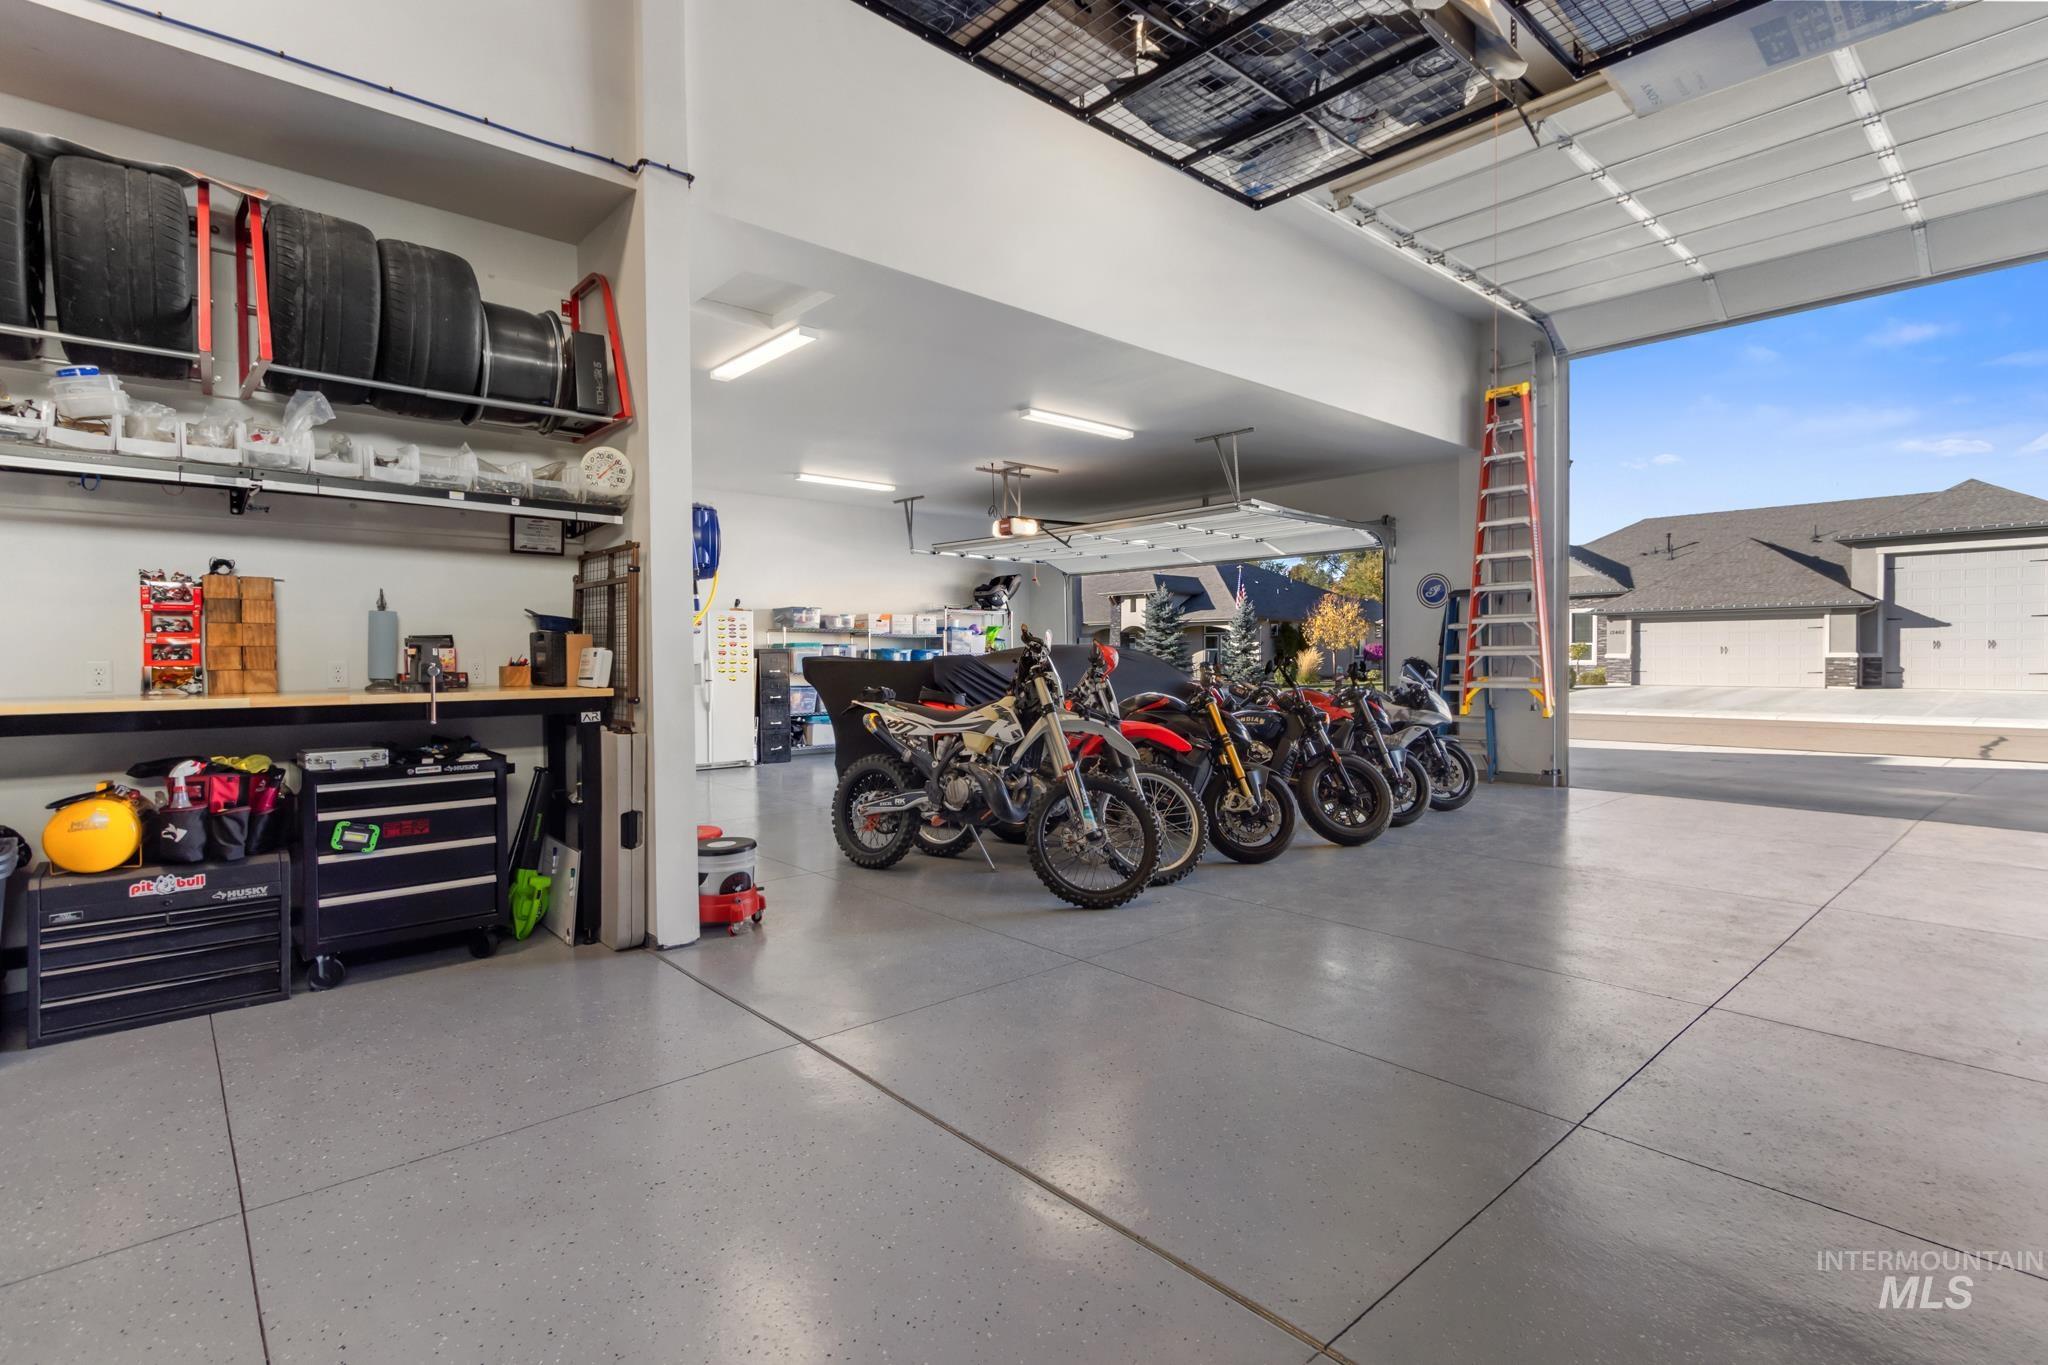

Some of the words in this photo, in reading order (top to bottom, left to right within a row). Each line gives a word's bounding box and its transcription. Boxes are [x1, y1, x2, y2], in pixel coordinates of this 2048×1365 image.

[131, 880, 153, 896] pit
[176, 875, 204, 888] bull
[227, 886, 269, 898] HUSKY
